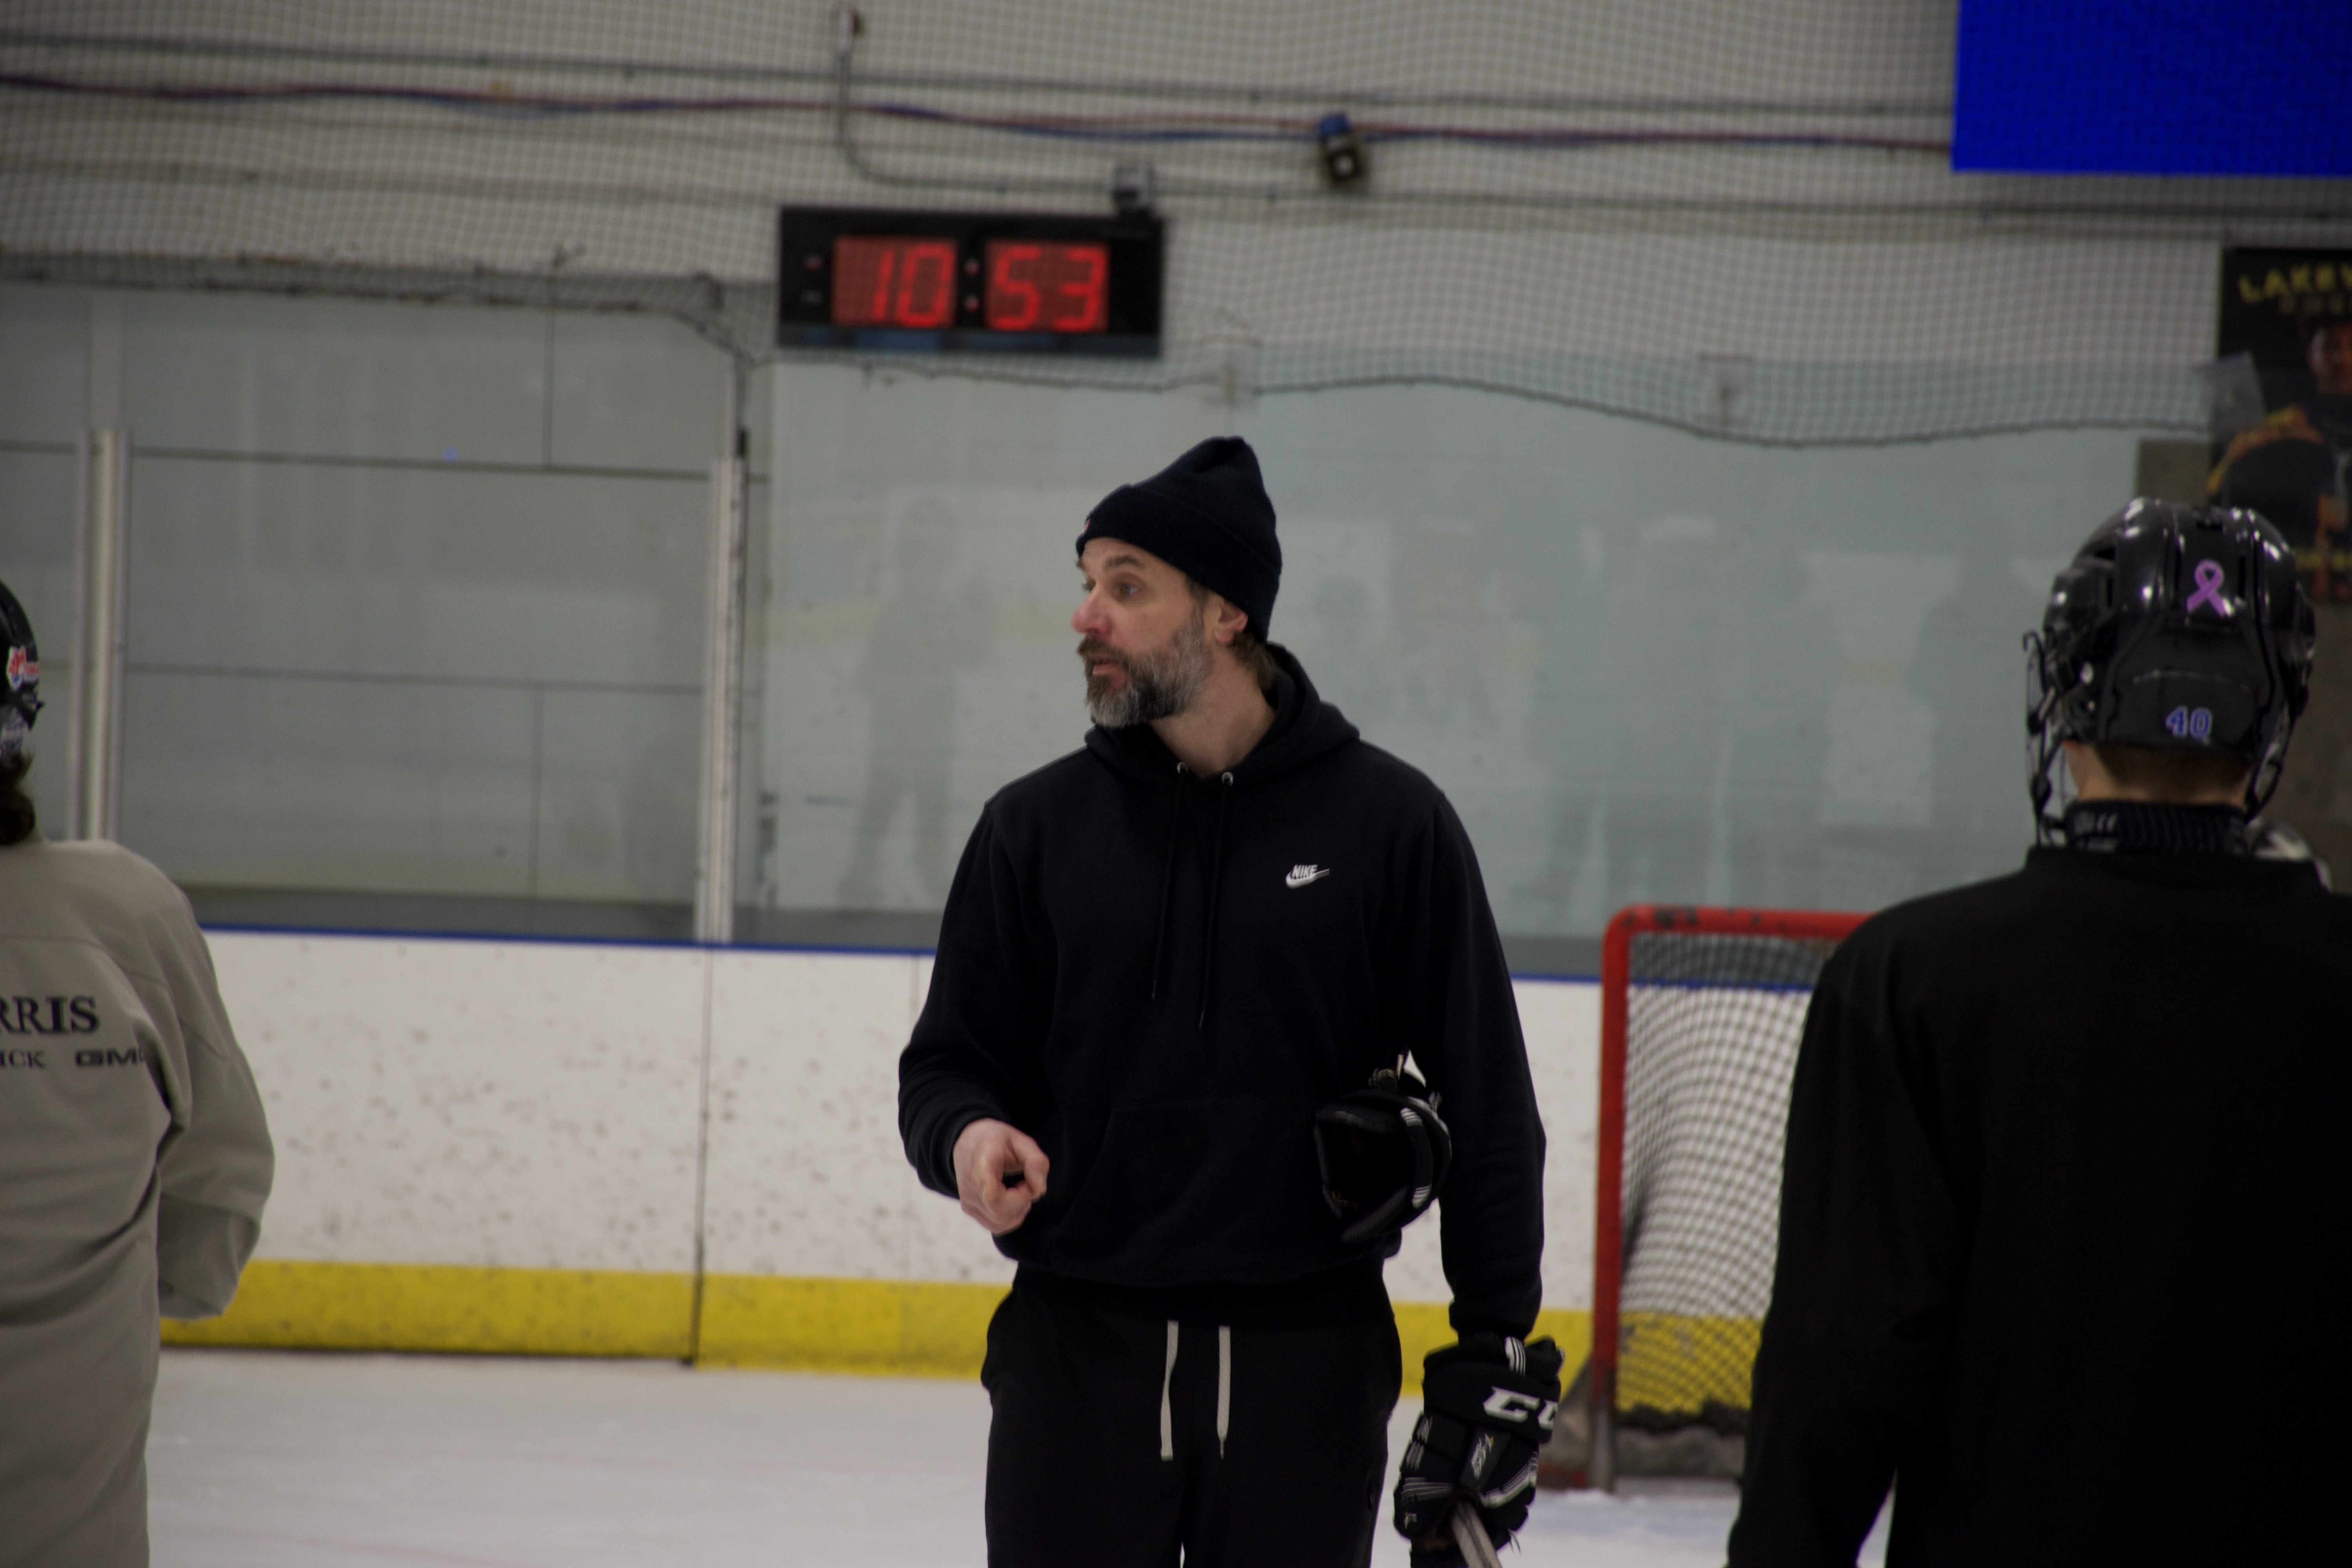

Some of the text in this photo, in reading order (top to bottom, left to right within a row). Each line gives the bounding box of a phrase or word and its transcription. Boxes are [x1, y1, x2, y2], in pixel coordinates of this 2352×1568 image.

[2164, 705, 2214, 739] 40
[1291, 864, 1318, 880] NIKE
[75, 1049, 143, 1066] GM
